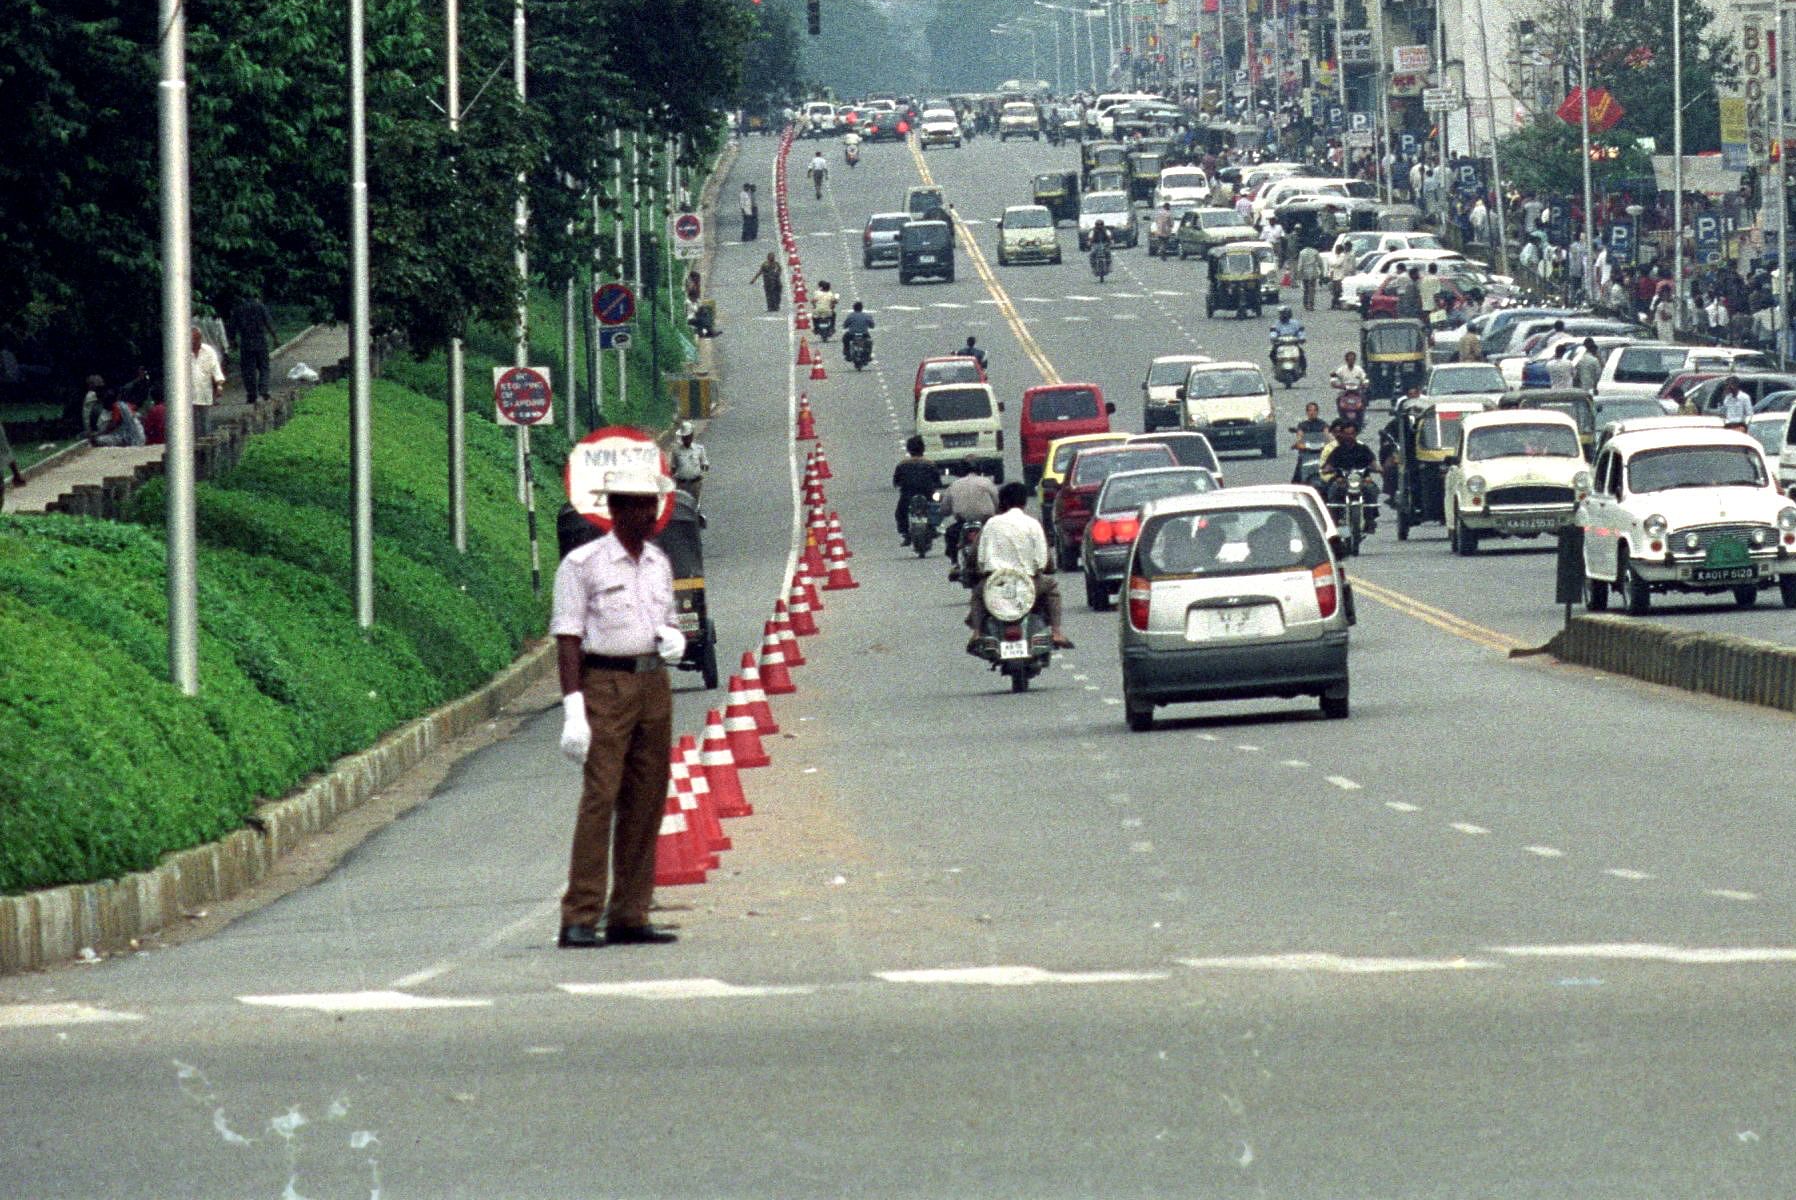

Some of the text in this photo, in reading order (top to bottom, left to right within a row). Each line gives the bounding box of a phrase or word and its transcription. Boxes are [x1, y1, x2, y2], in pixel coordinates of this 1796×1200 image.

[1330, 107, 1342, 123] P
[1352, 114, 1366, 129] P
[1402, 135, 1416, 151] P
[1460, 165, 1475, 183] P
[1612, 226, 1628, 247] P
[1699, 217, 1716, 240] P
[584, 450, 617, 467] NON
